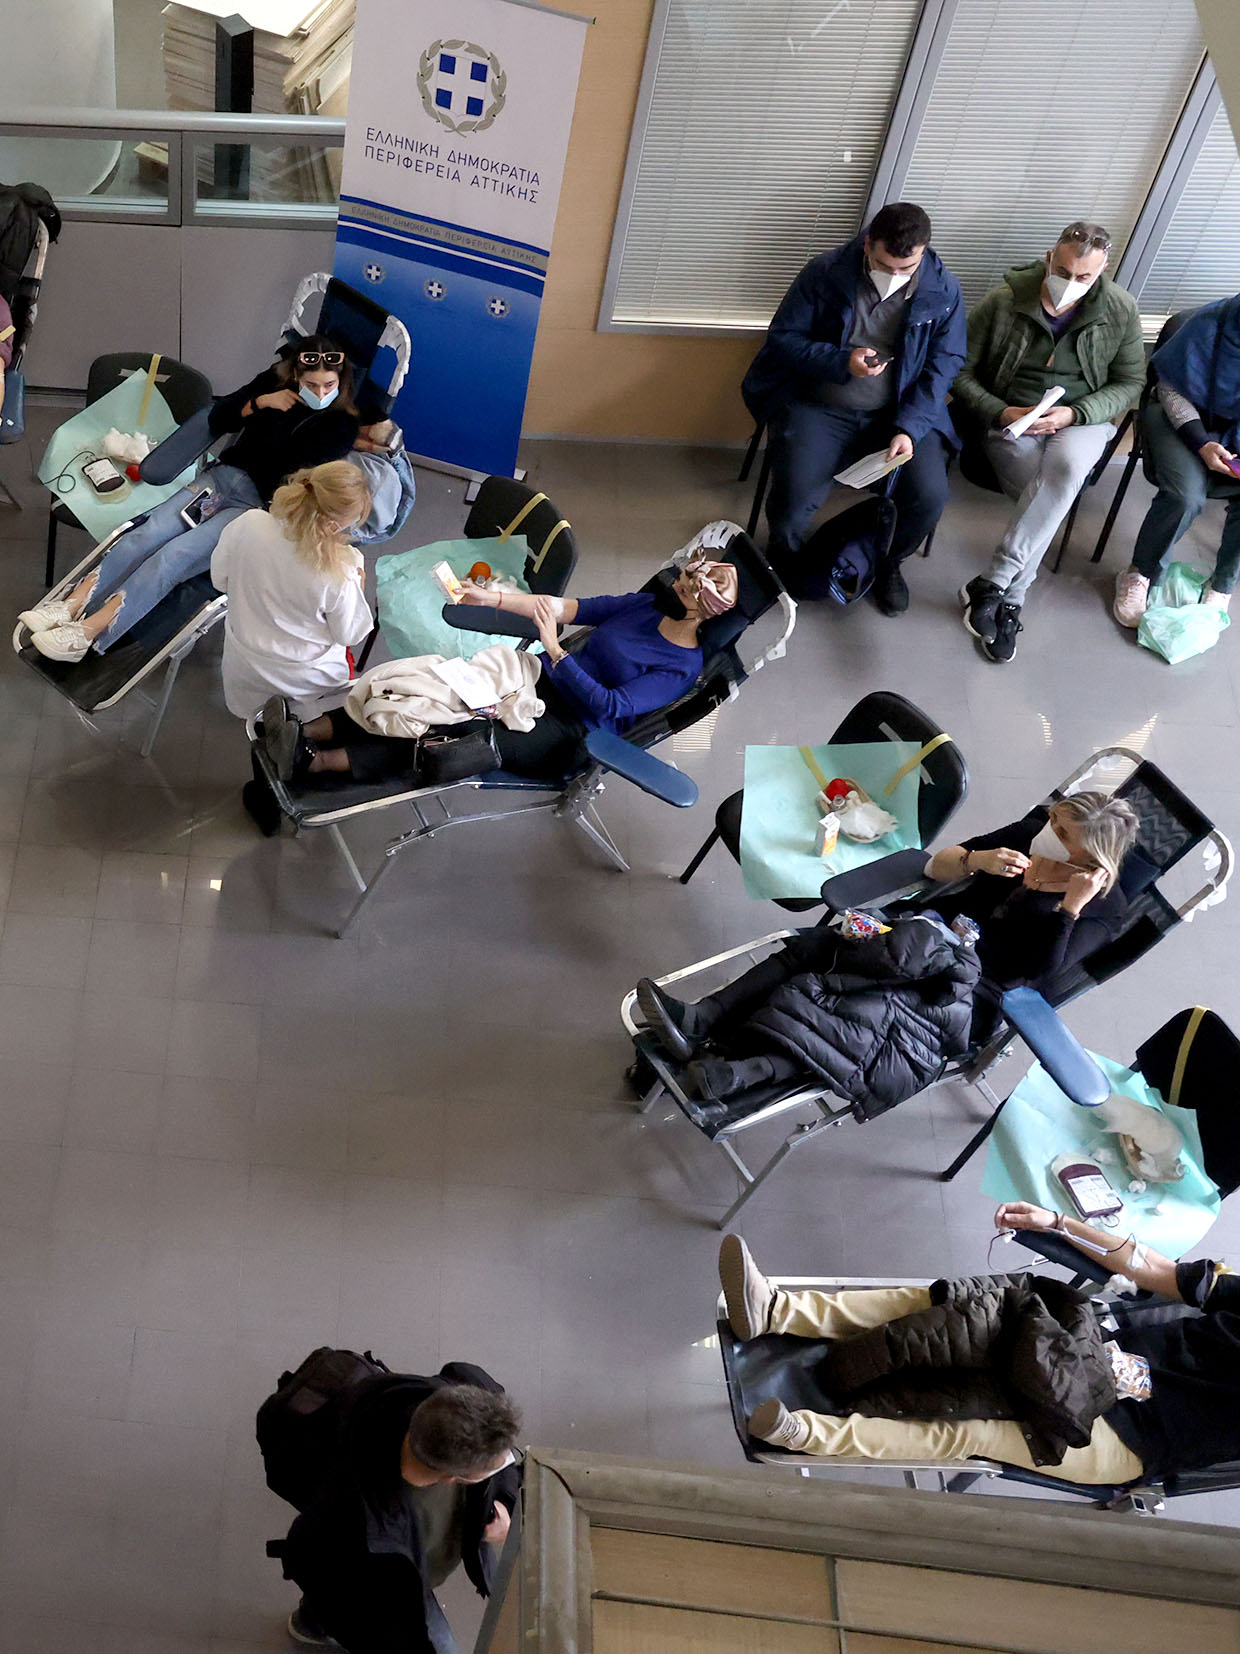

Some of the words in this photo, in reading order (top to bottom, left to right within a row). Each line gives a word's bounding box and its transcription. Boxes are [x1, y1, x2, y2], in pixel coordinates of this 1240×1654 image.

[364, 145, 461, 183] ΠΕΡΙΦΕΡΕΙΑ
[470, 174, 539, 204] ΑΤΤΙΚΗΣ
[366, 127, 440, 159] ΕΛΛΗΝΙΚΗ
[447, 150, 541, 186] ΔΗΜΟΚΡΑΤΙΑ
[444, 231, 497, 252] ΠΕΡΙΦΕΡΕΙΑ
